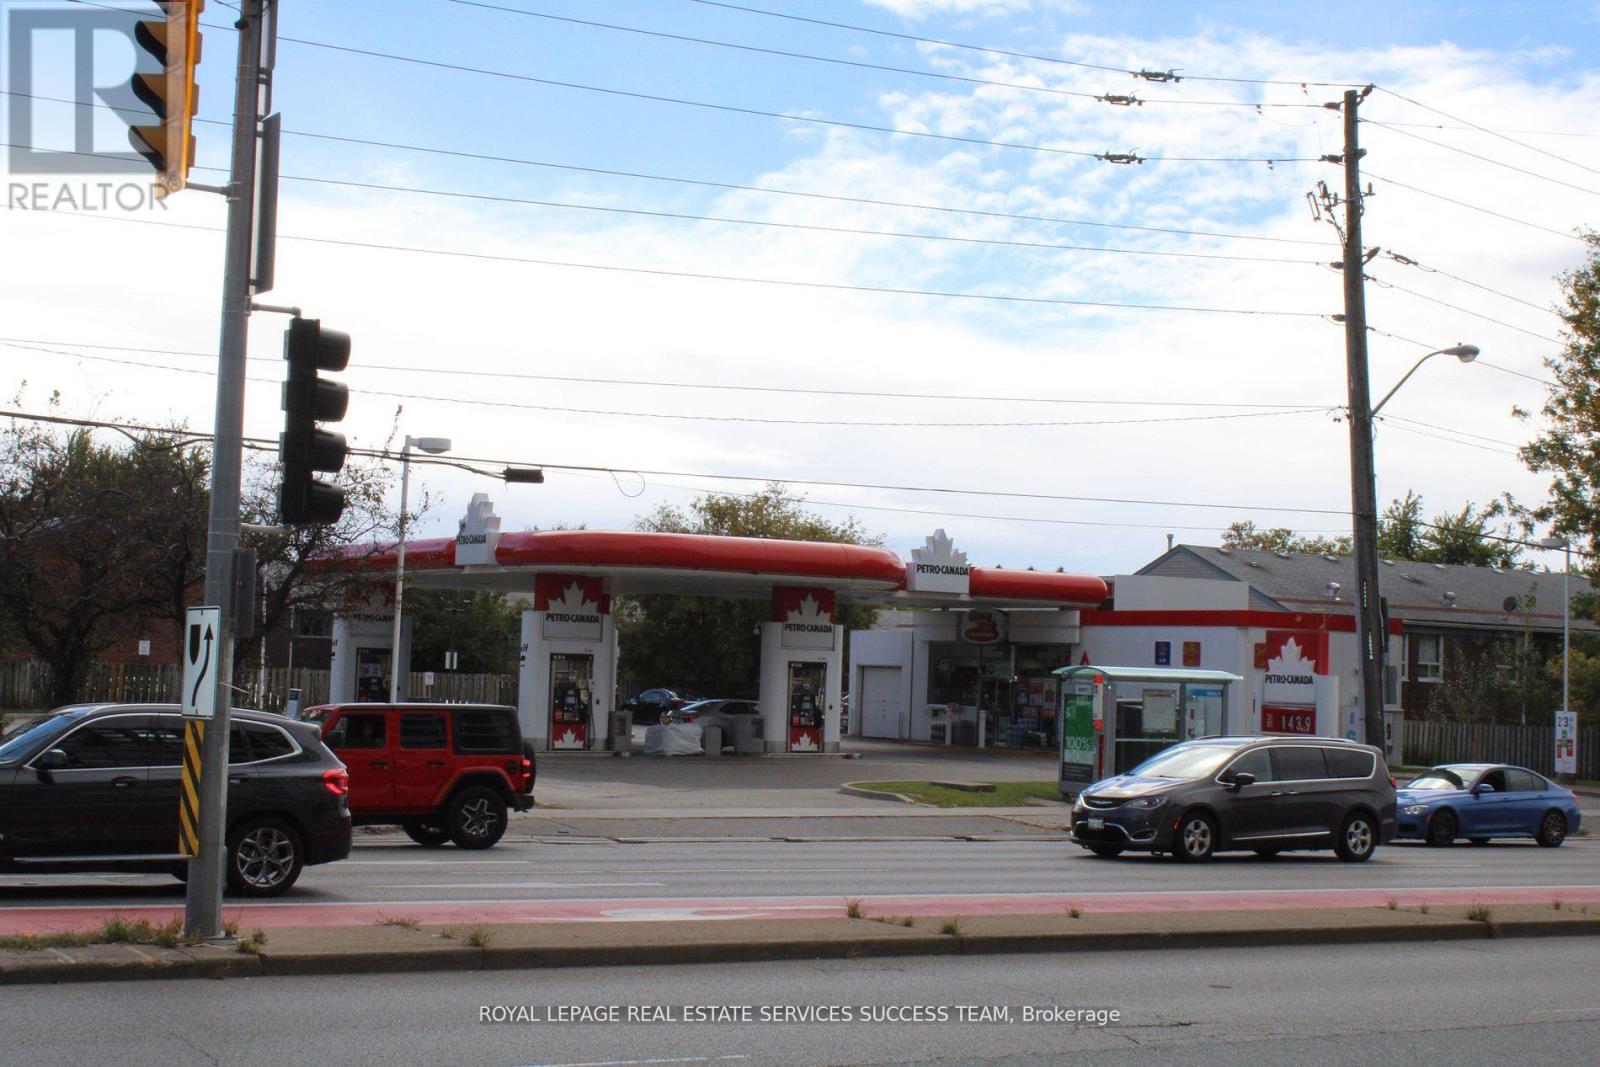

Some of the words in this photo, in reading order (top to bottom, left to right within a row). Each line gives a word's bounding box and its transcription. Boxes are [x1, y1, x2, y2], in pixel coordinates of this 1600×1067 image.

[916, 564, 968, 575] PETRO-CANADA
[545, 613, 600, 624] PETRO-CANADA
[784, 623, 832, 633] PETRO-CANADA
[1265, 674, 1314, 685] PETRO-CANADA
